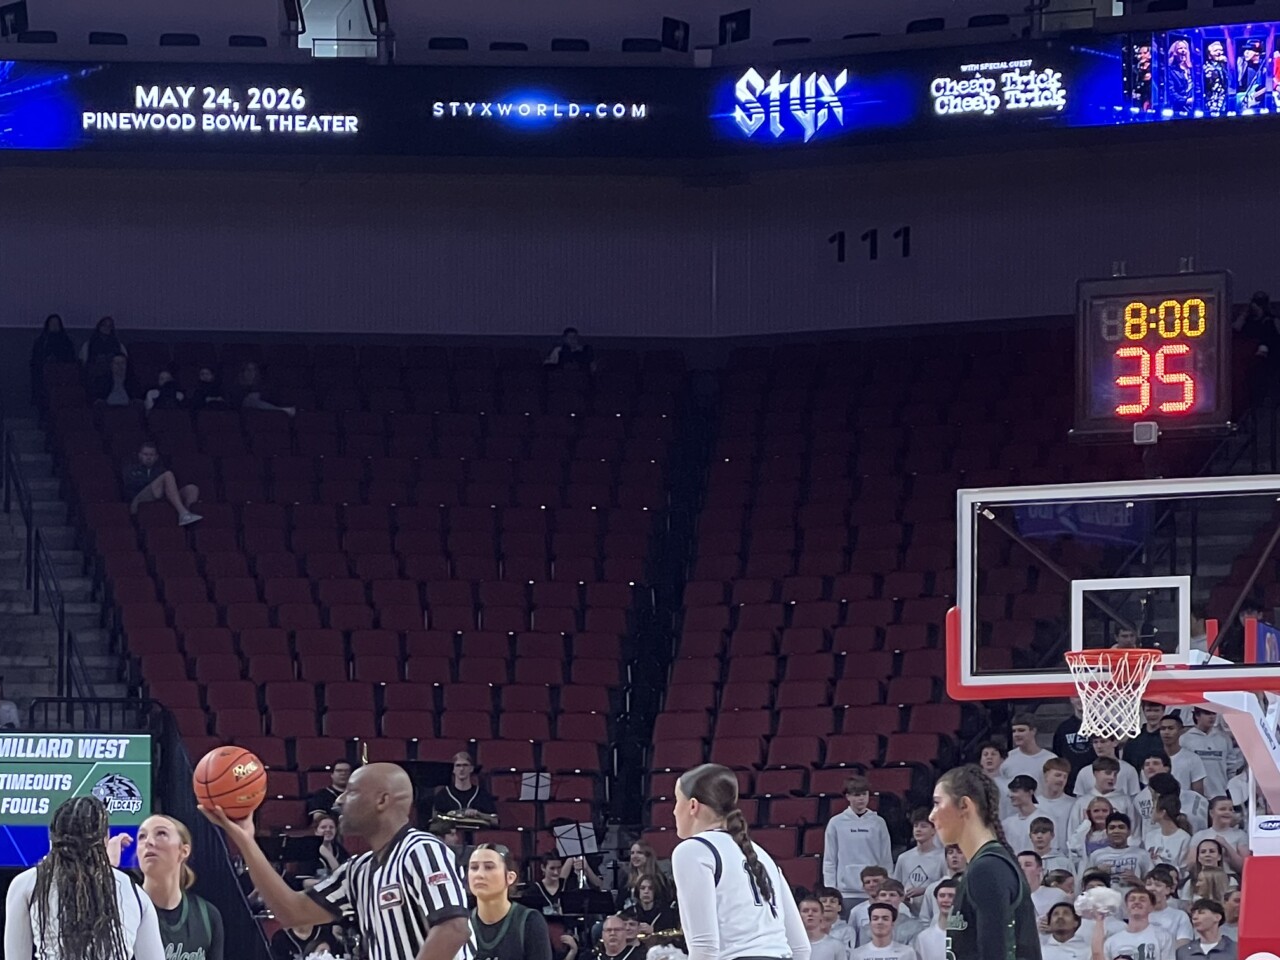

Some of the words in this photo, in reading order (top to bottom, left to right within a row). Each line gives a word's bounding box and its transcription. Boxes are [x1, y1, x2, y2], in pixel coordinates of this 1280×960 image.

[980, 61, 1008, 70] SPECIAL
[1009, 59, 1033, 68] GUEST
[931, 72, 996, 97] Cheap
[1001, 68, 1062, 91] Trick
[135, 86, 195, 109] MAY
[203, 88, 239, 112] 24,
[247, 88, 305, 110] 2026
[934, 94, 1001, 115] Cheap
[433, 102, 646, 118] STYXWORLD.COM
[82, 112, 196, 130] PINEWOOD
[202, 113, 261, 131] BOWL
[262, 114, 358, 132] THEATER
[828, 227, 910, 263] 111
[1124, 299, 1206, 340] 8:00
[1115, 344, 1194, 414] 35
[78, 739, 129, 759] WEST
[1, 798, 49, 814] FOULS
